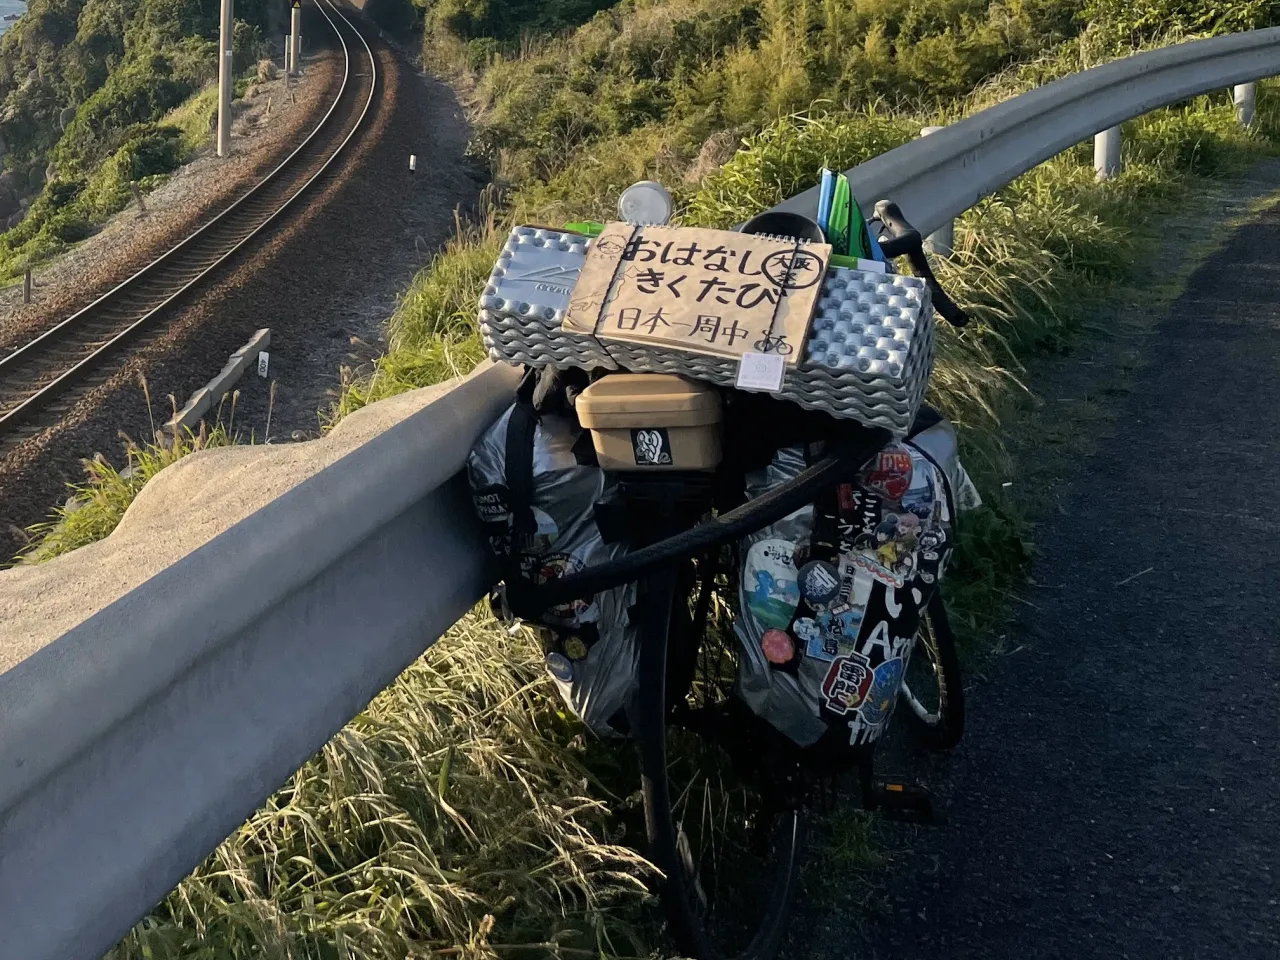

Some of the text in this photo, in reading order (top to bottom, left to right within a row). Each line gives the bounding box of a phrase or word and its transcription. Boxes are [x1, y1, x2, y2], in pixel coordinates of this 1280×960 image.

[622, 236, 762, 276] おはなし
[770, 254, 815, 272] 大阪
[636, 267, 788, 309] きくたび
[617, 307, 749, 347] 日本一周中
[829, 659, 867, 707] 雷門
